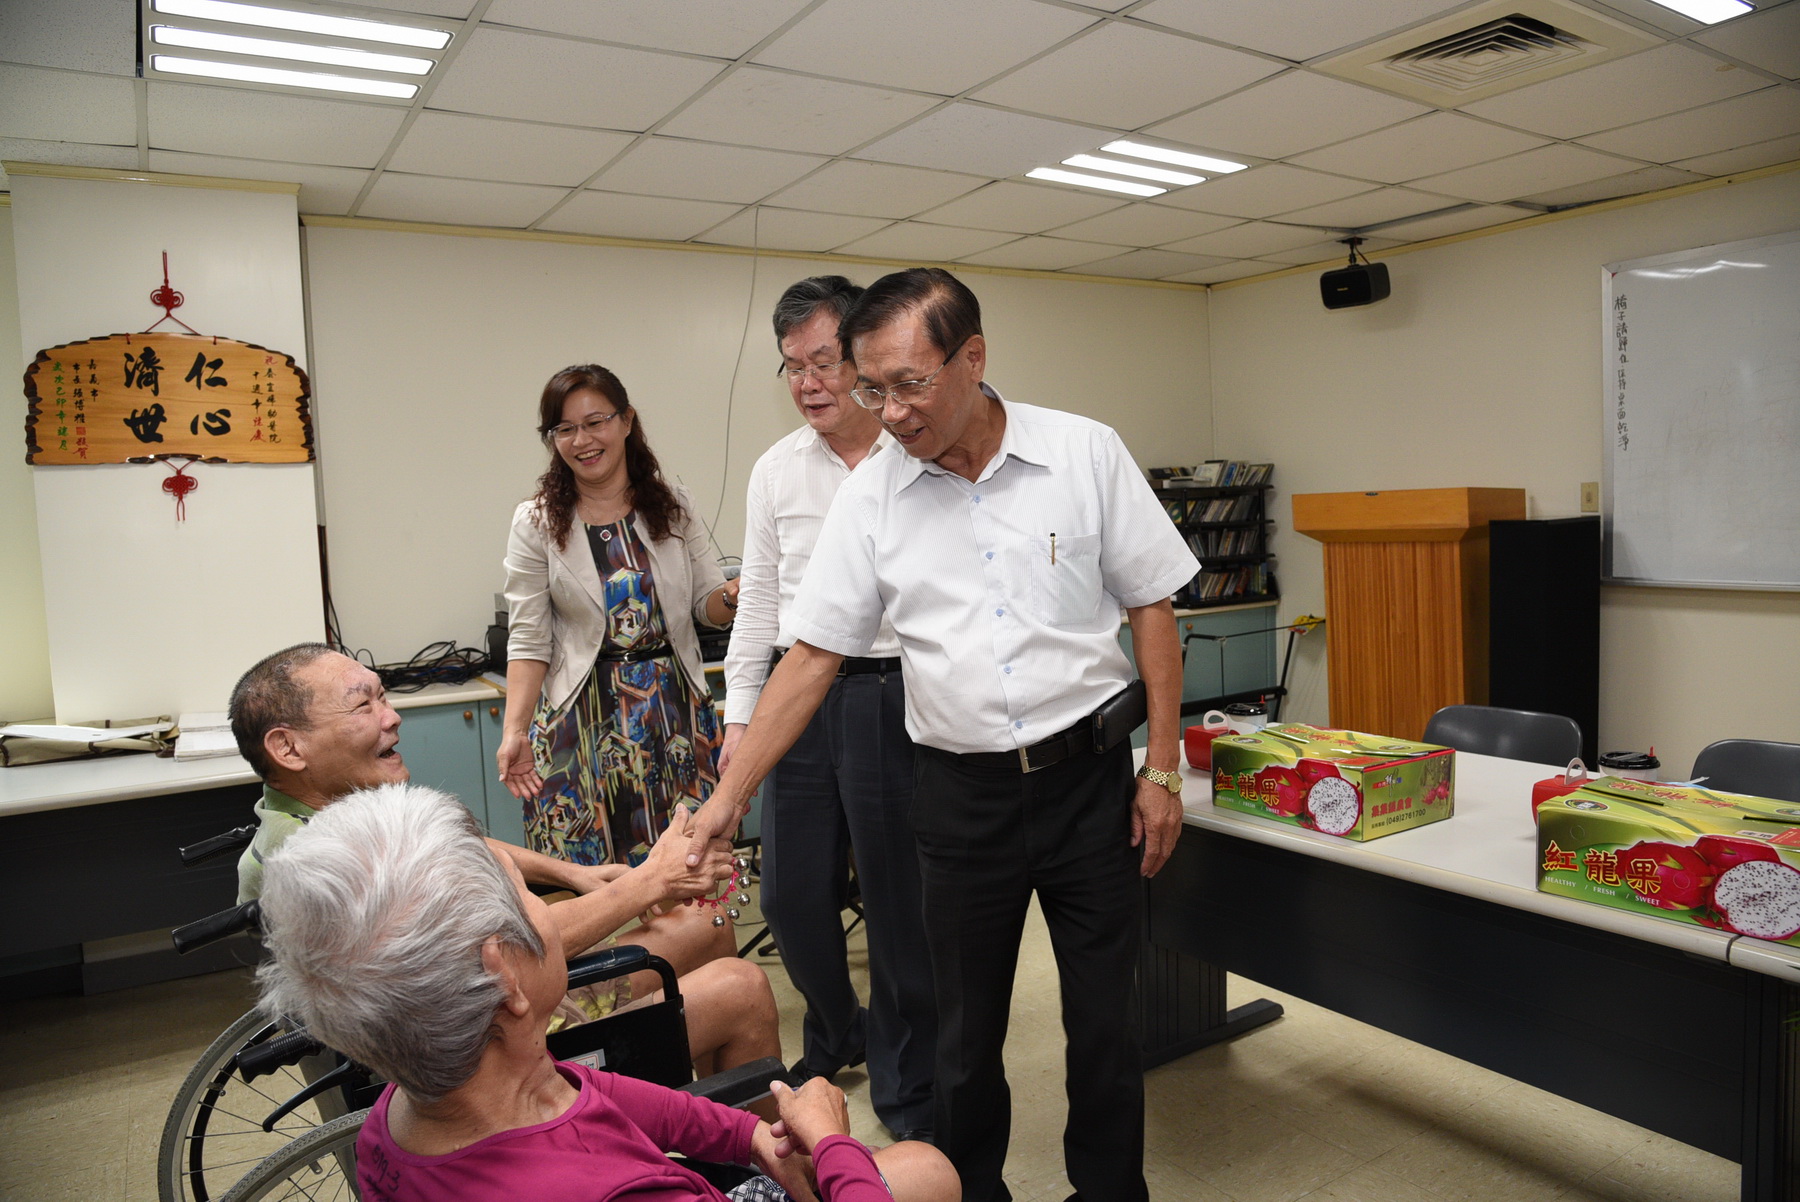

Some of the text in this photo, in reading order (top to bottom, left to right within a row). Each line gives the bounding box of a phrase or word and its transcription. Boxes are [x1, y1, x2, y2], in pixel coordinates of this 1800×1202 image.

[123, 347, 167, 443] 濟世
[185, 352, 231, 436] 仁心
[1215, 767, 1280, 807] 紅龍果
[1242, 801, 1256, 809] FRESH
[1543, 840, 1661, 895] 紅龍果
[1545, 876, 1577, 887] HEALTHY
[1593, 886, 1616, 897] FRESH
[1635, 895, 1660, 906] SWEET
